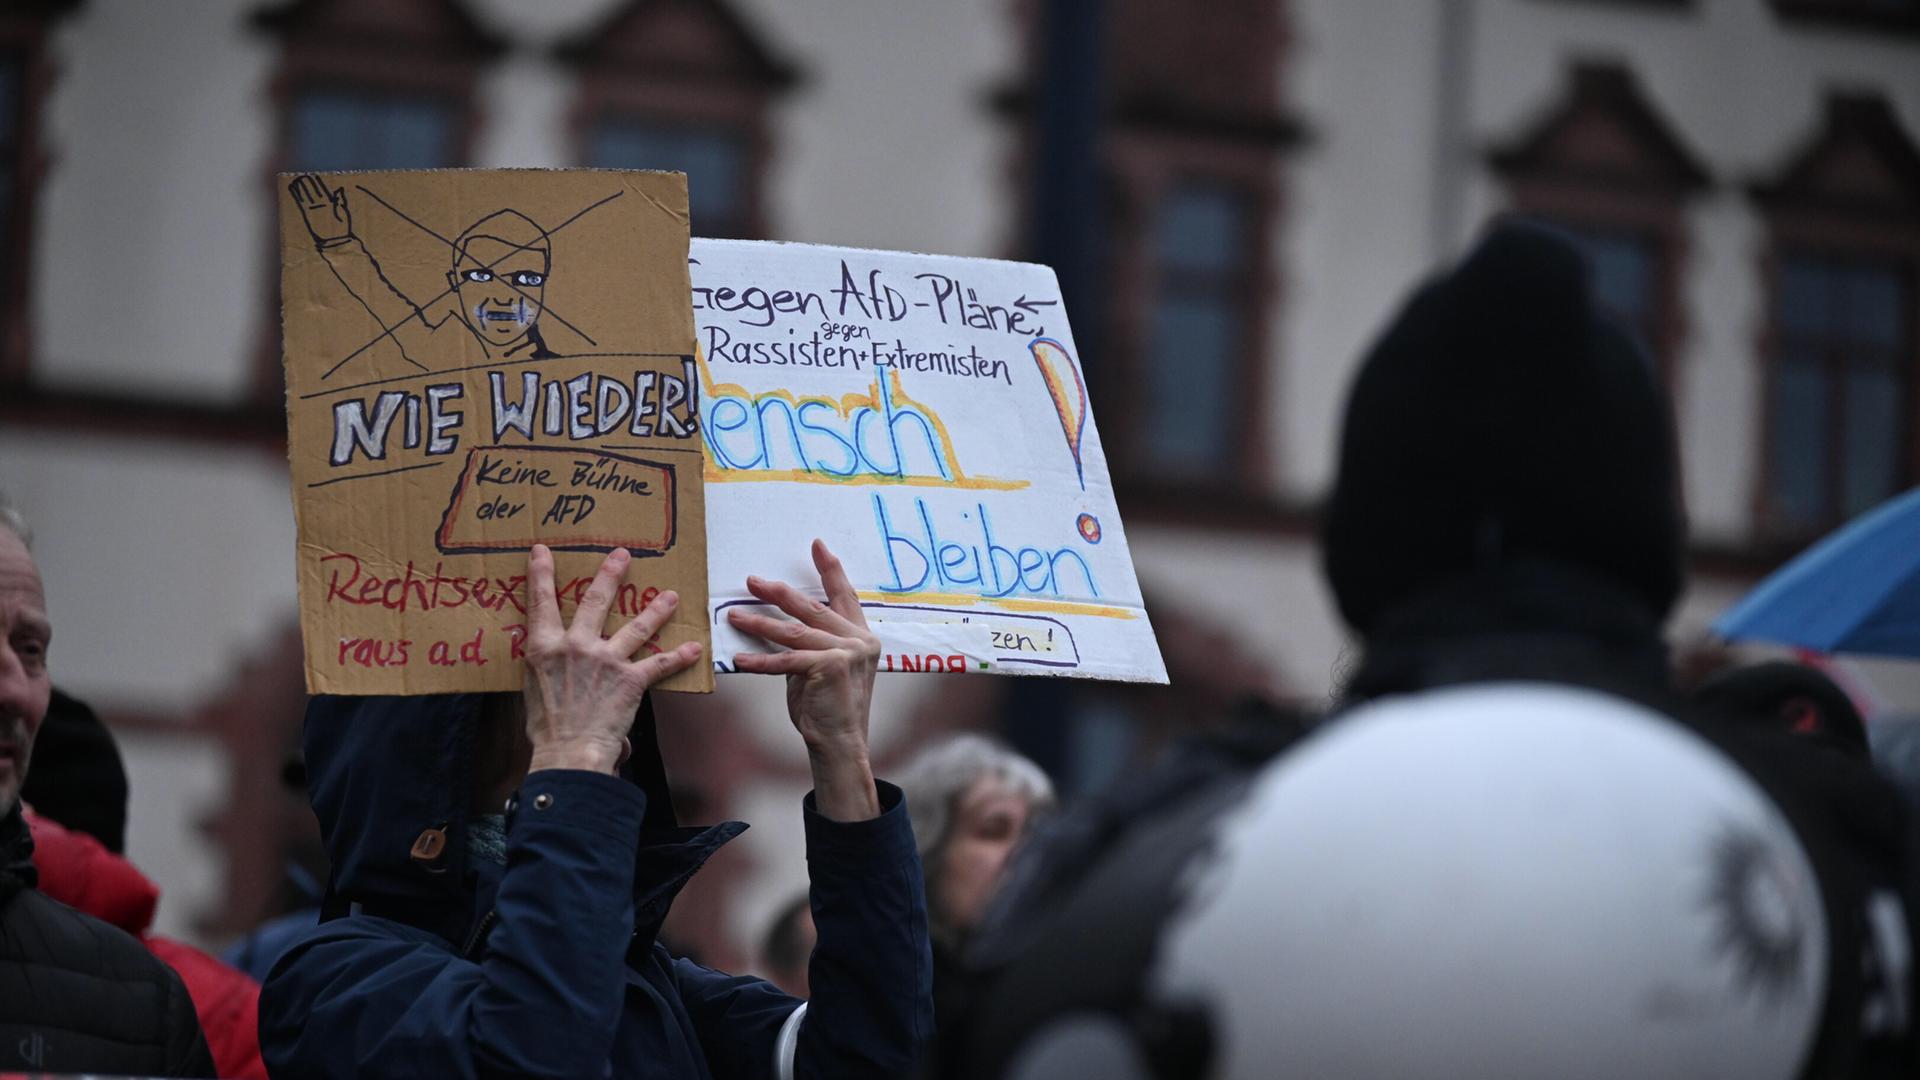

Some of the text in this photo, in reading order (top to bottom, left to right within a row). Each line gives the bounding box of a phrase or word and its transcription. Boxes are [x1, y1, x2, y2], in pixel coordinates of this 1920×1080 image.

[820, 321, 871, 342] gegen
[329, 356, 699, 467] NIE WIEDER!
[700, 365, 949, 481] ensch
[476, 454, 652, 496] Keine Bühne
[476, 494, 596, 526] der AFD
[873, 494, 1097, 597] bleiben
[338, 638, 413, 667] raus
